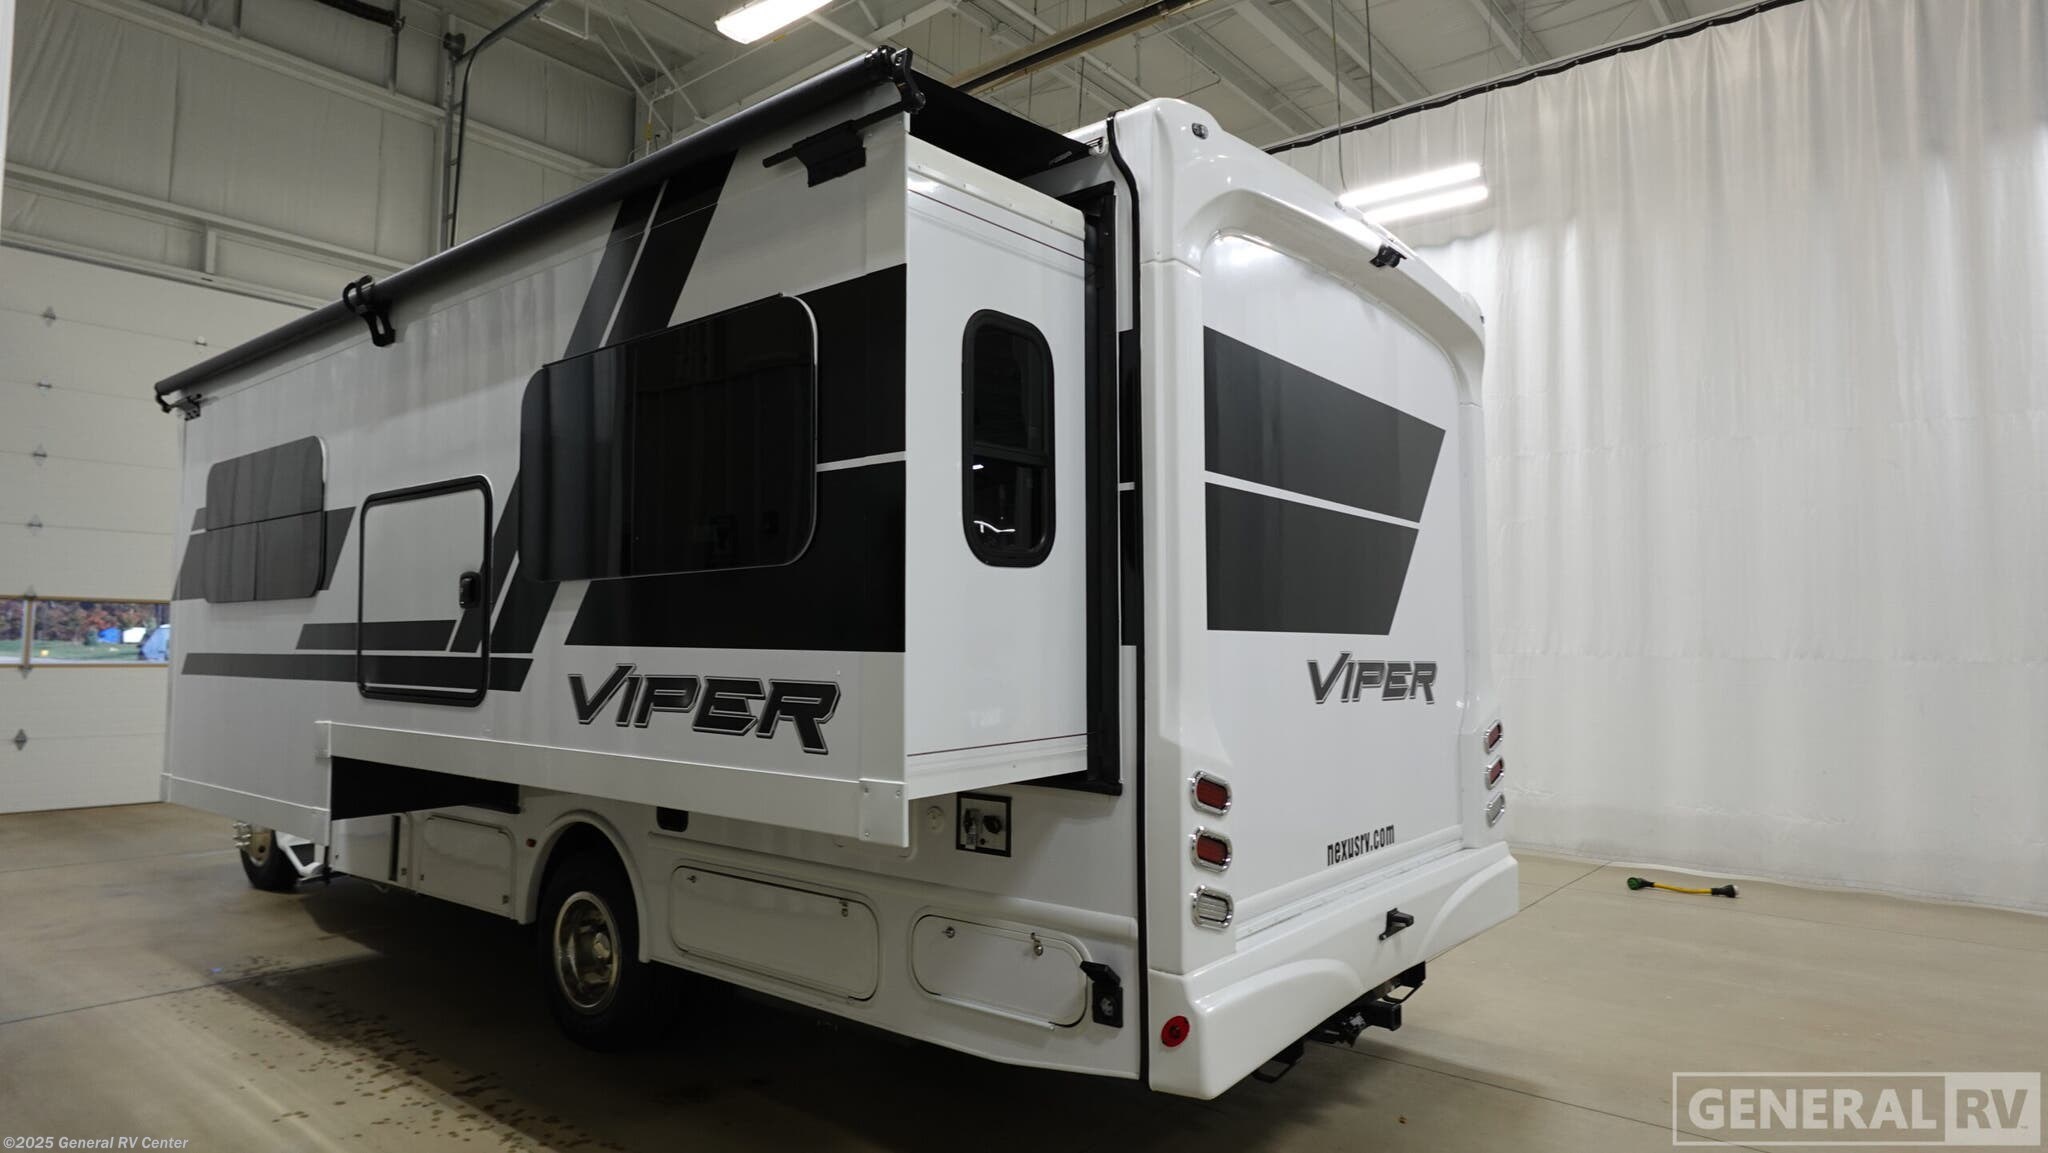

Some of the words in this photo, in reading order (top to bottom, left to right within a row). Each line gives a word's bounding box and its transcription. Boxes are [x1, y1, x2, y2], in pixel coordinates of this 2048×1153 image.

[1306, 651, 1438, 705] VIPER
[568, 663, 841, 755] VIPER
[1327, 825, 1395, 866] nexusrv.com
